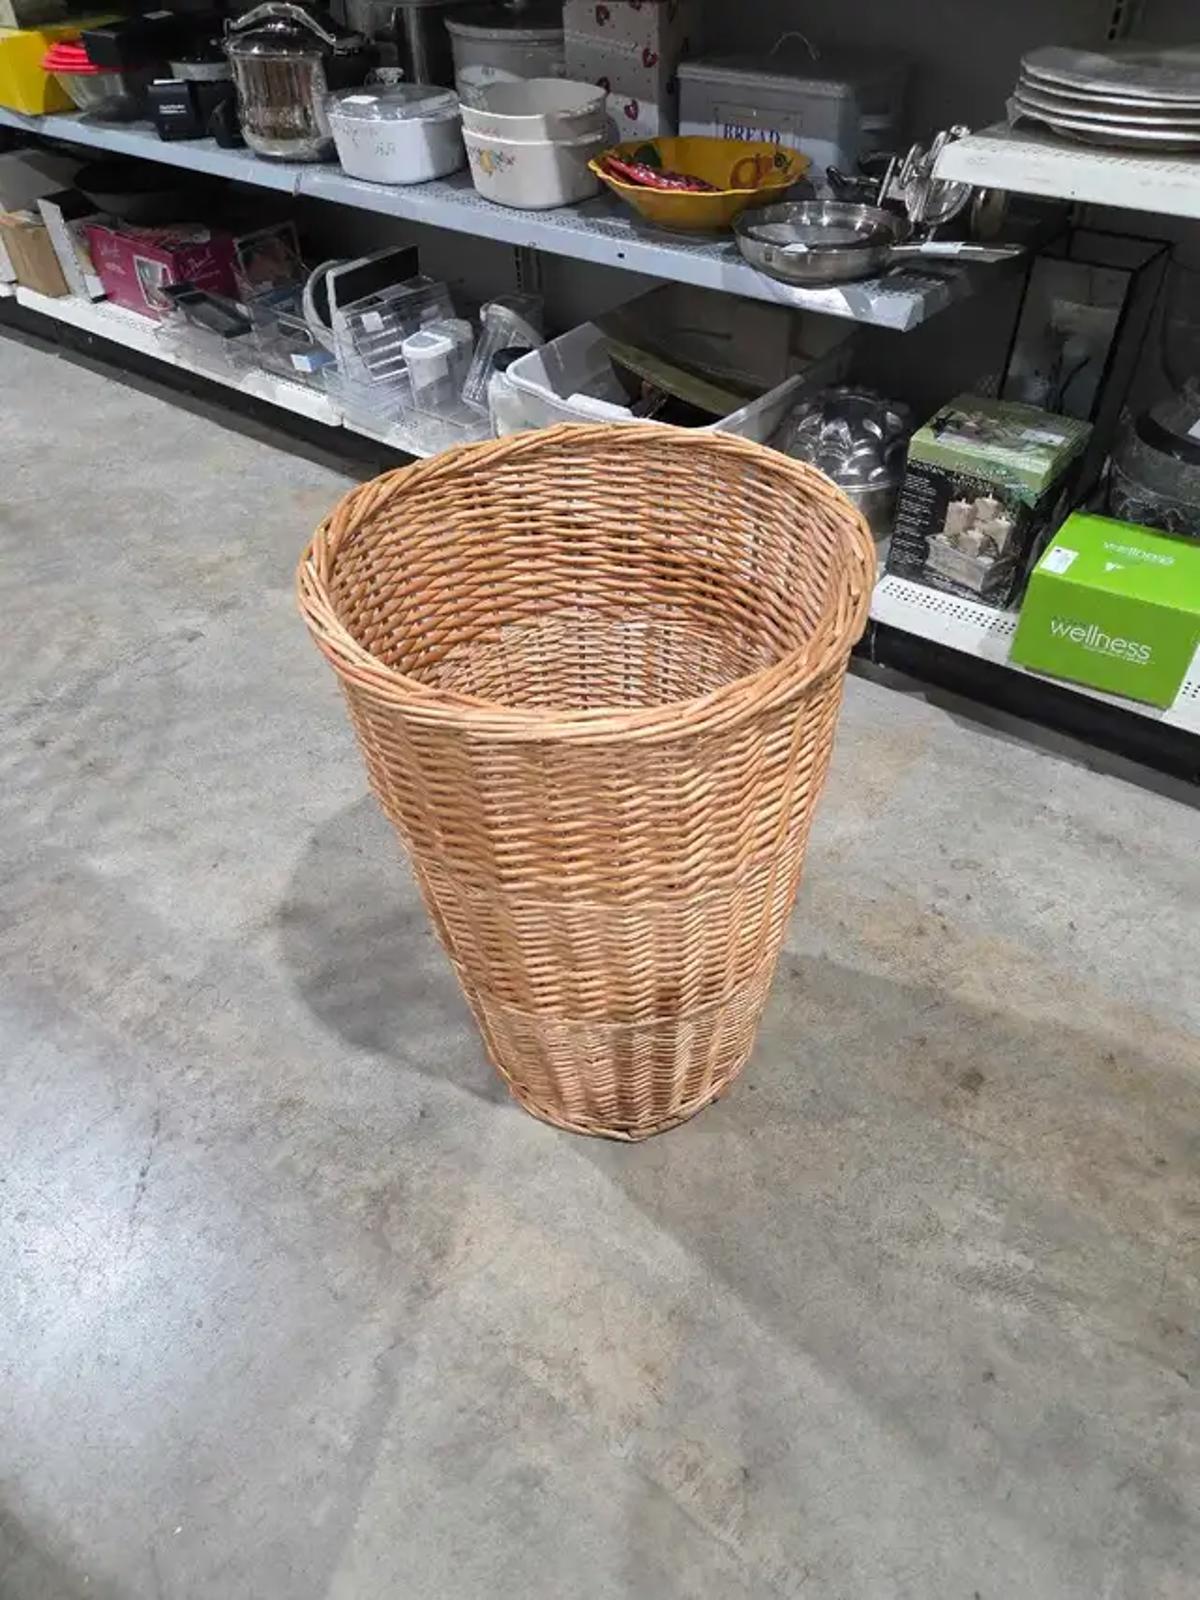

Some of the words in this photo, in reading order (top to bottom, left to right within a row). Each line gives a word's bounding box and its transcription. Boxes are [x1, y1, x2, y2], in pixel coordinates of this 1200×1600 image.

[723, 123, 781, 145] BREAD
[1103, 541, 1175, 566] wellness
[1050, 618, 1152, 661] wellness
